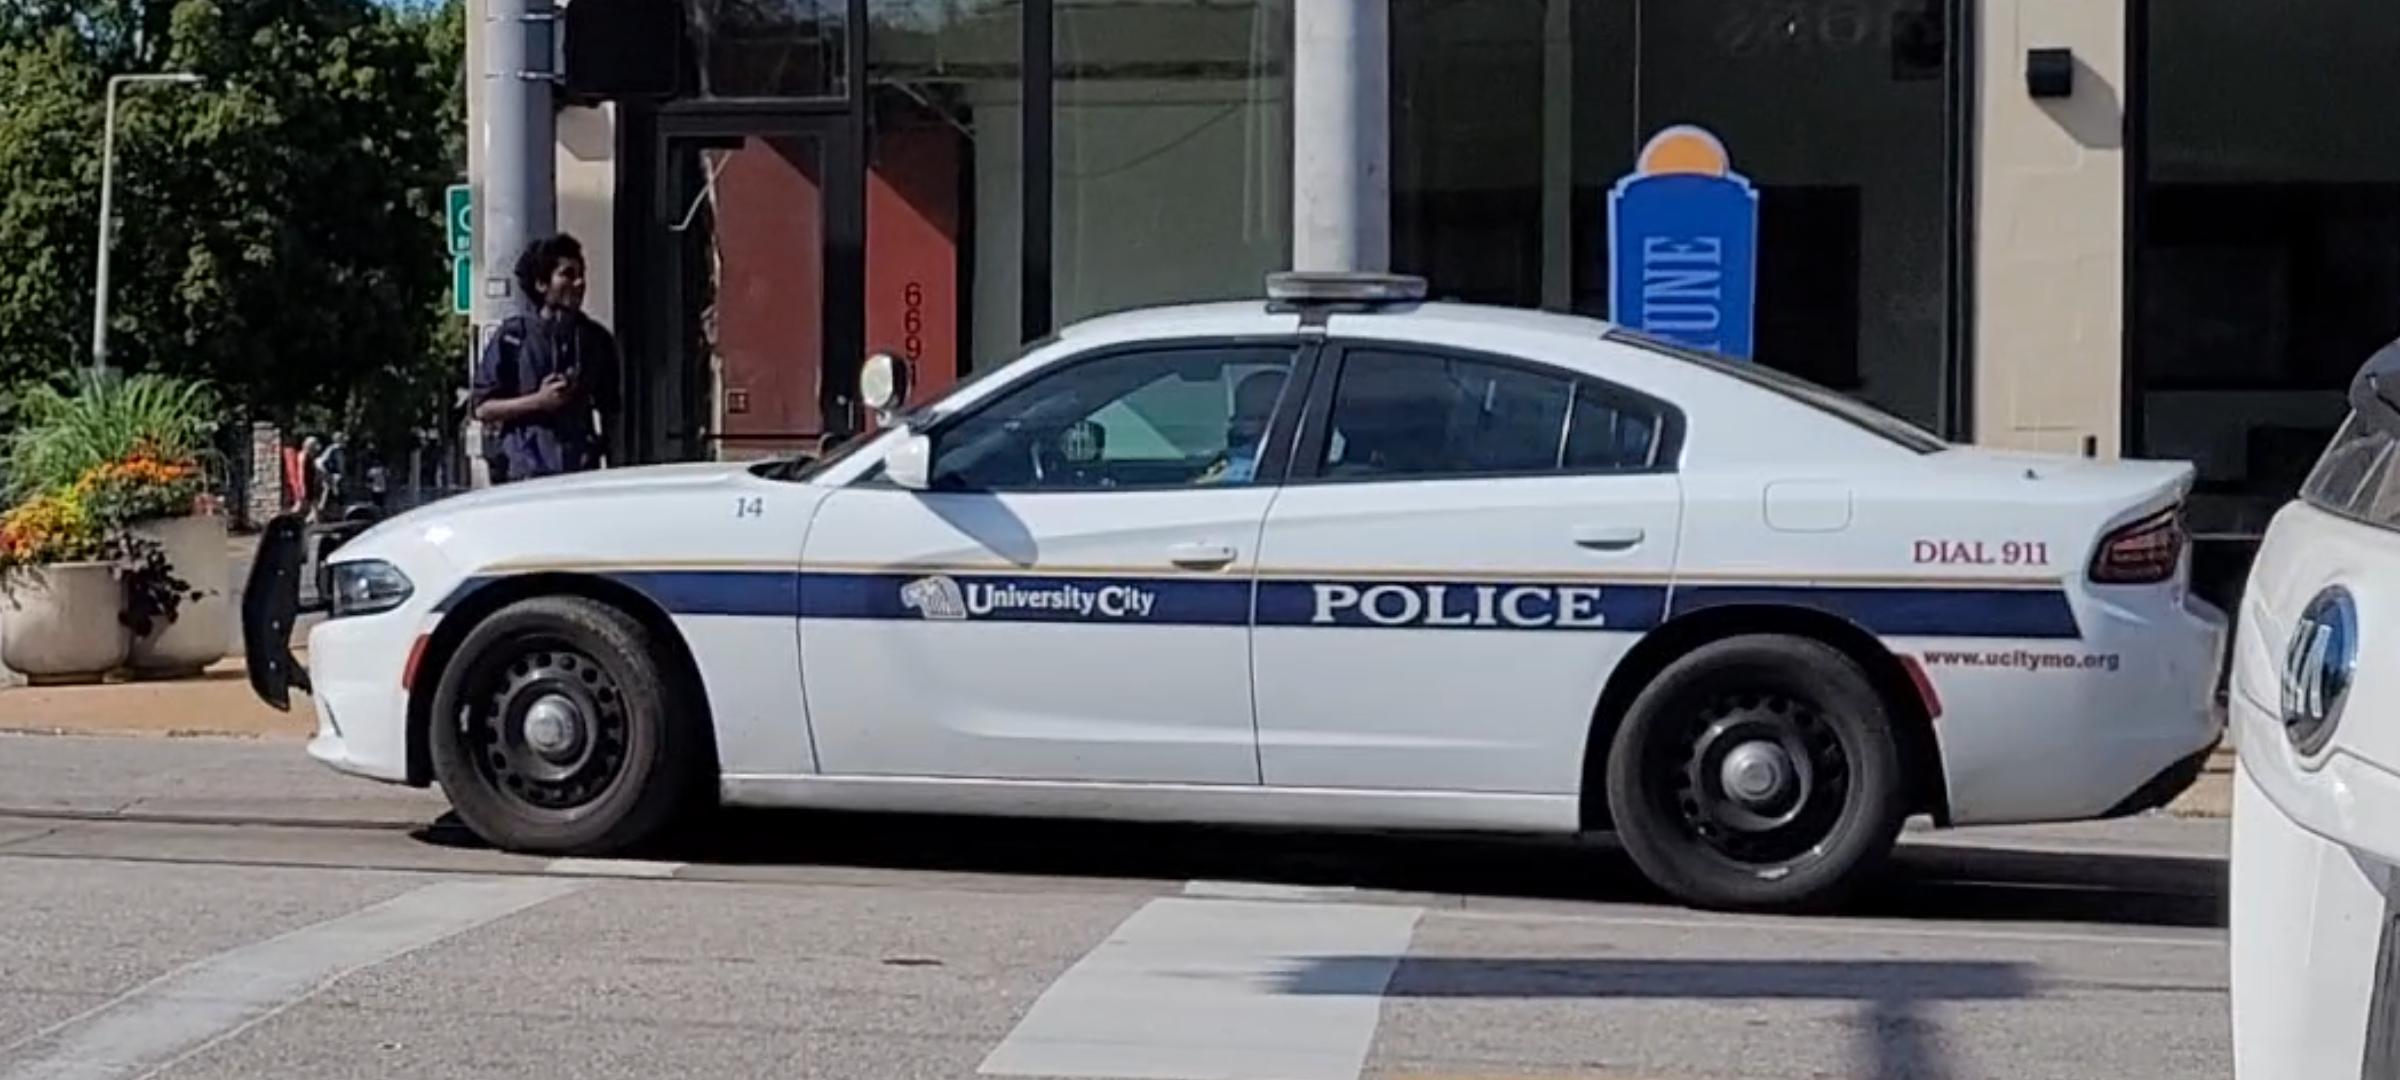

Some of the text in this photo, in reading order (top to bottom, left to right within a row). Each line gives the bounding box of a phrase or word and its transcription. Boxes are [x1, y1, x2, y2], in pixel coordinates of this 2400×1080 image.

[905, 282, 921, 387] 6691
[736, 497, 763, 518] 14
[1913, 540, 2048, 565] DIAL 911
[967, 584, 1155, 616] University City
[1312, 583, 1604, 626] POLICE
[1924, 649, 2119, 671] www.ucitymo.org
